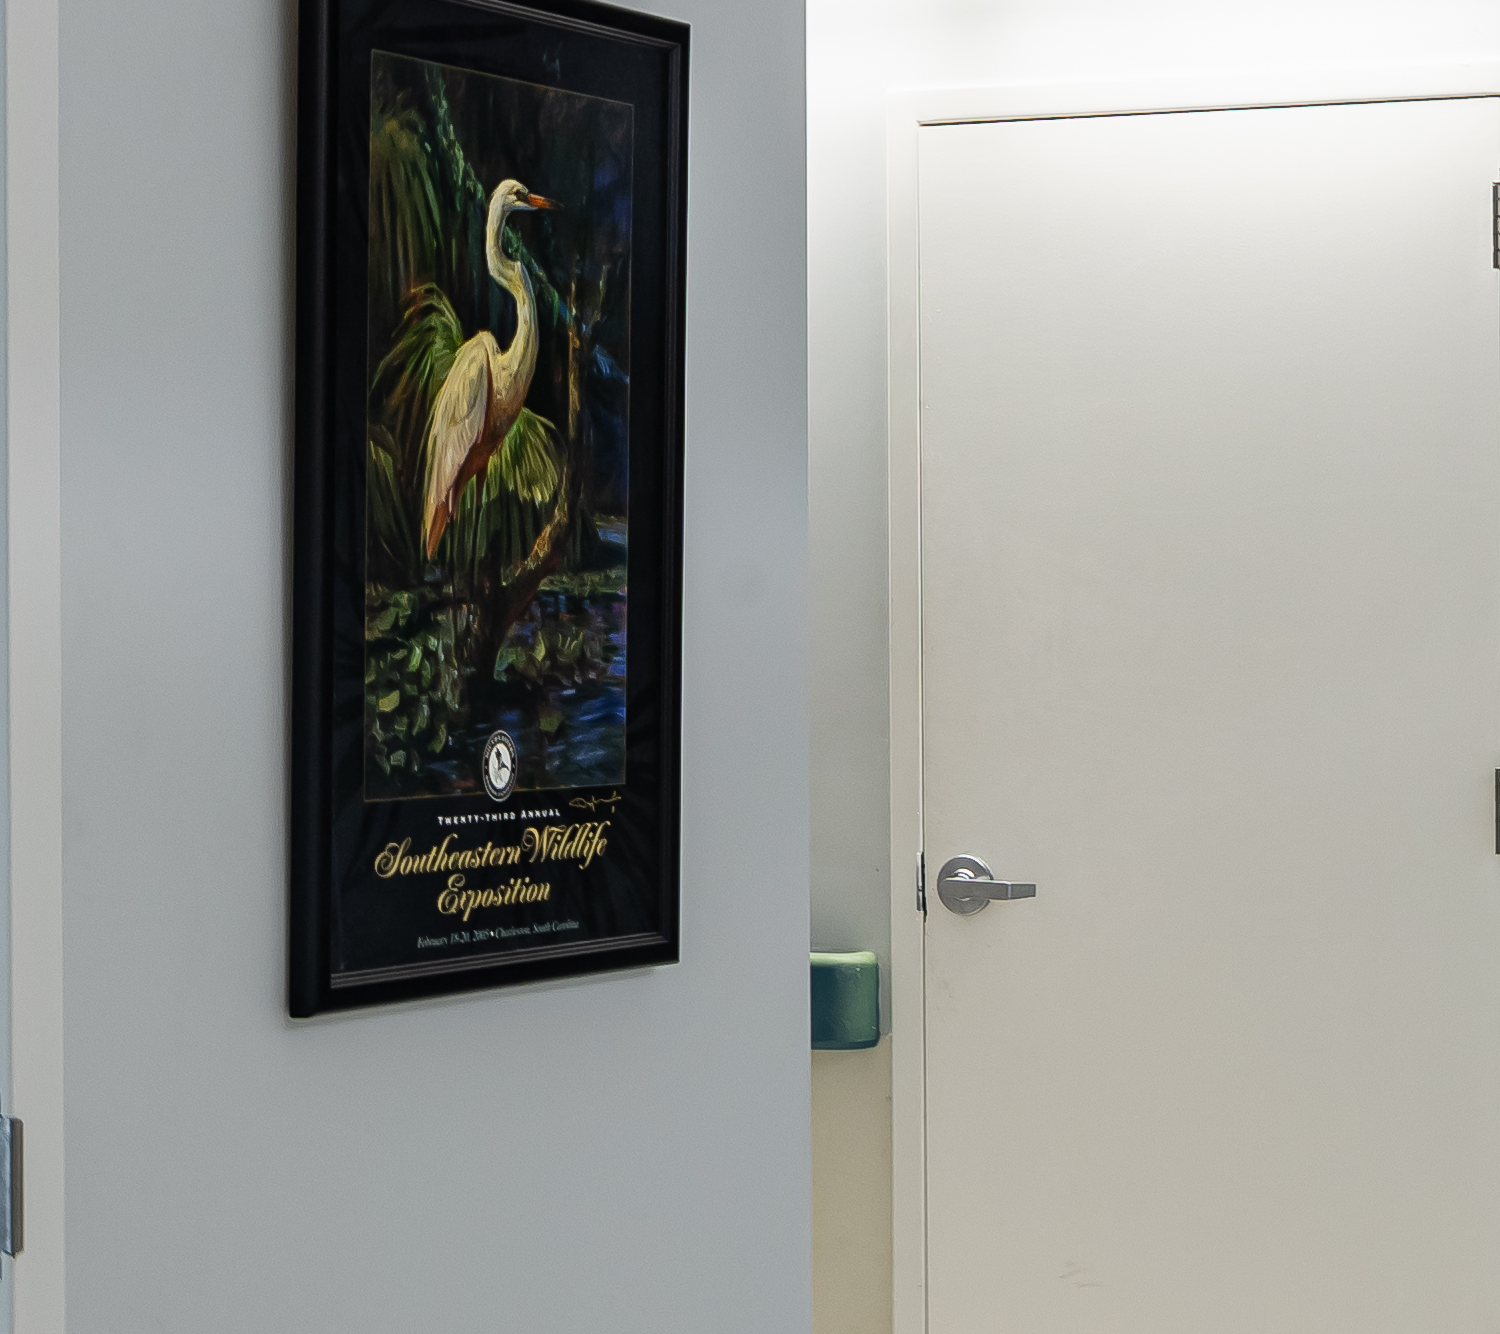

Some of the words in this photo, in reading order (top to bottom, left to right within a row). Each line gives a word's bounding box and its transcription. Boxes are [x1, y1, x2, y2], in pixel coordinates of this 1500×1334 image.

[520, 808, 561, 819] ANNUAL
[374, 833, 521, 878] Southeastern
[521, 820, 611, 870] Wildlife
[437, 873, 551, 922] Exposition
